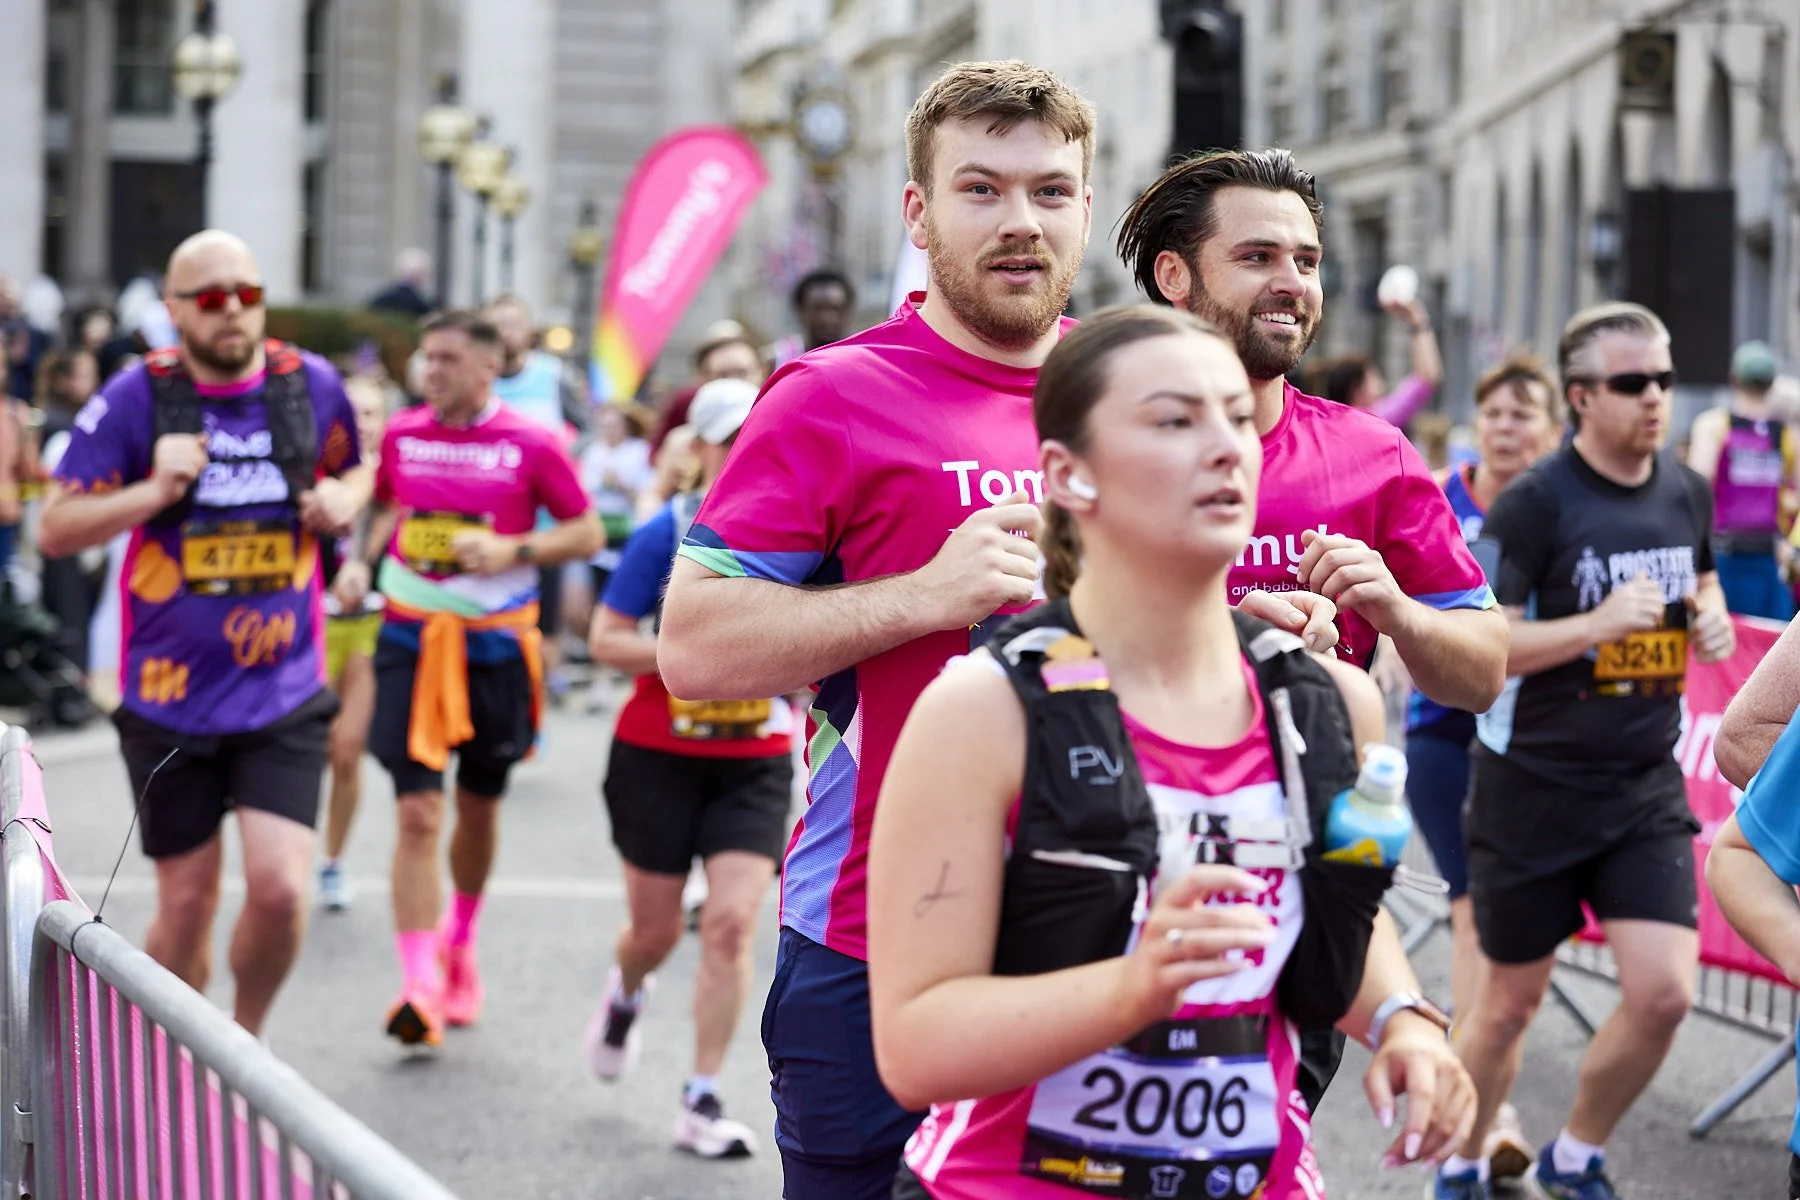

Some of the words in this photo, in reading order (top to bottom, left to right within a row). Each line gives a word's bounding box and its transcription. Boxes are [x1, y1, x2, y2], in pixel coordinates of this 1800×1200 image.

[620, 160, 731, 298] Tommy's
[396, 435, 523, 470] Tommy's
[202, 543, 277, 567] 4774
[1608, 546, 1694, 582] PROSTATE
[1232, 582, 1258, 596] and
[1263, 581, 1299, 594] baby
[1611, 641, 1678, 669] 3241
[1168, 1029, 1197, 1051] EM
[1073, 1066, 1249, 1138] 2006
